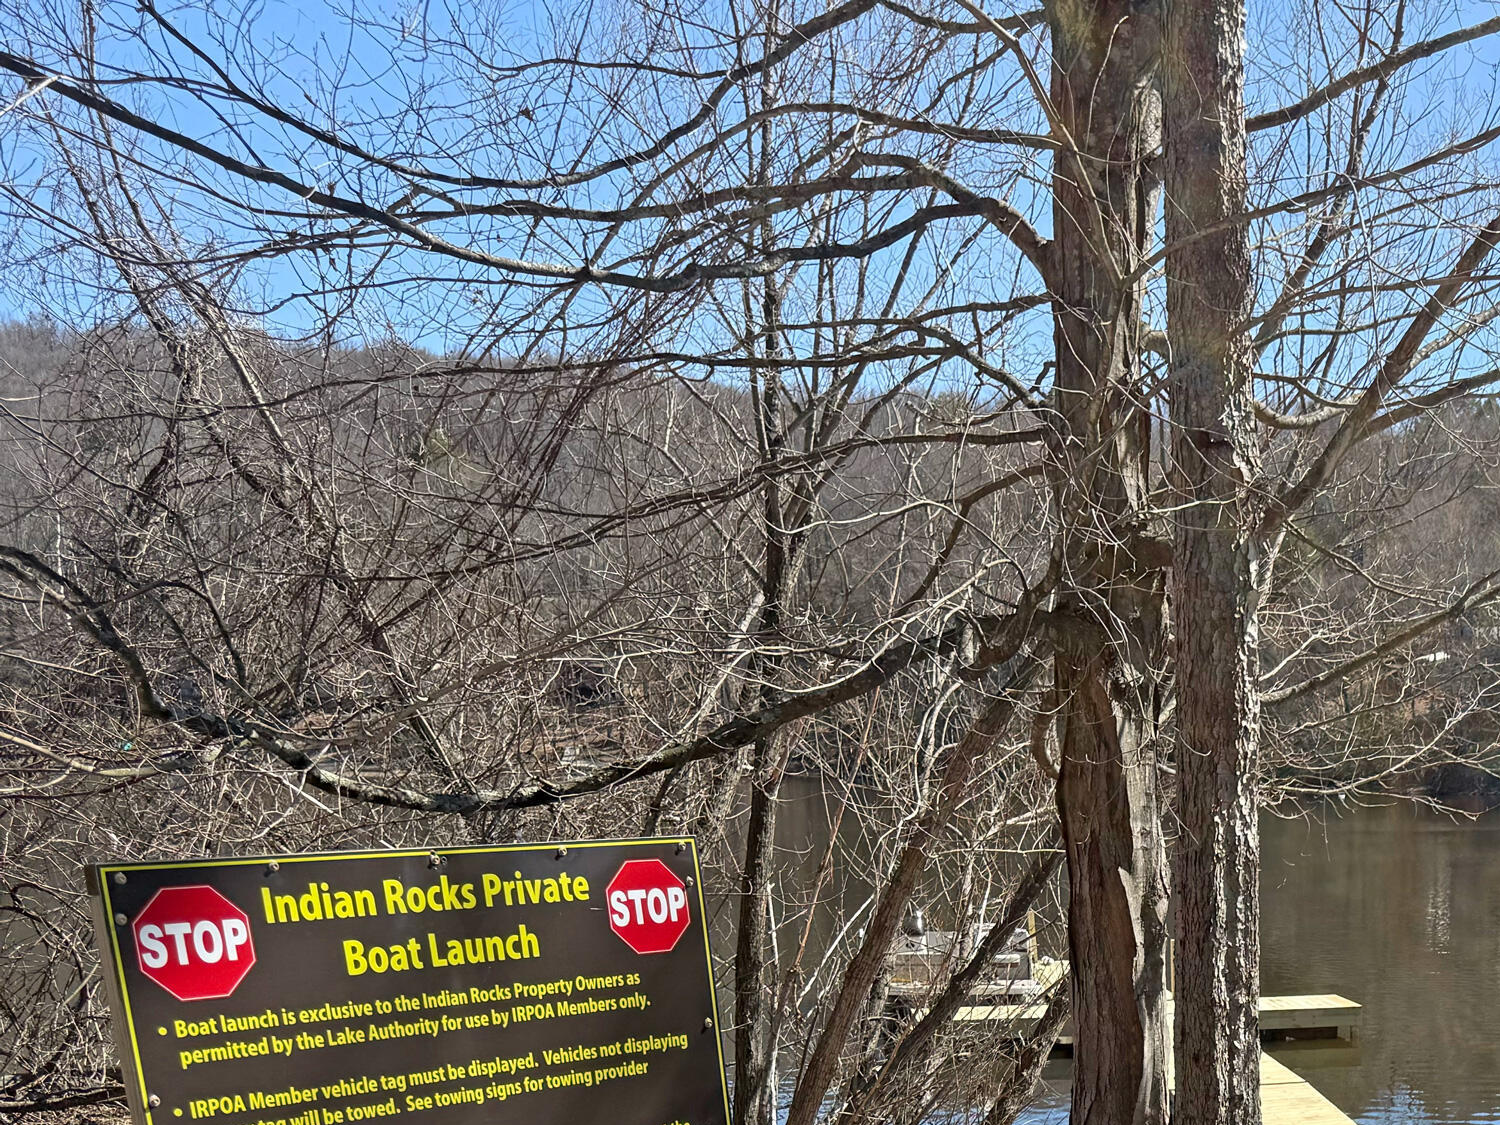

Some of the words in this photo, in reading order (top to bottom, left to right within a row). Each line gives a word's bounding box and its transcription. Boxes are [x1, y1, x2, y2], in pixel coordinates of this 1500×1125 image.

[261, 881, 378, 924] Indian
[382, 874, 477, 915] Rocks
[482, 870, 590, 907] Private
[610, 886, 686, 927] STOP
[139, 918, 249, 969] STOP
[342, 937, 424, 976] Boat
[427, 924, 541, 968] Launch
[173, 1017, 219, 1038] Boat
[219, 1009, 280, 1033] launch
[281, 1008, 297, 1026] is
[298, 1000, 373, 1024] exclusive
[374, 999, 393, 1015] to
[394, 994, 421, 1012] the
[422, 990, 469, 1009] Indian
[469, 984, 512, 1004] Rocks
[513, 978, 573, 1000] Property
[575, 974, 625, 991] Owners
[626, 973, 641, 986] as
[179, 1036, 270, 1070] permitted
[271, 1035, 293, 1057] by
[295, 1031, 325, 1050] the
[326, 1026, 366, 1047] Lake
[368, 1017, 440, 1041] Authority
[441, 1014, 463, 1032] for
[464, 1014, 490, 1029] use
[490, 1009, 509, 1028] by
[511, 1002, 556, 1023] IRPOA
[556, 997, 618, 1017] Members
[619, 991, 651, 1010] only.
[189, 1094, 247, 1119] IRPOA
[248, 1086, 319, 1111] Member
[320, 1075, 378, 1099] vehicle
[379, 1075, 407, 1093] tag
[408, 1066, 447, 1087] must
[447, 1063, 466, 1081] be
[467, 1051, 539, 1079] displayed.
[542, 1044, 598, 1066] Vehicles
[599, 1041, 622, 1058] not
[623, 1032, 688, 1055] displaying
[322, 1108, 344, 1125] be
[345, 1097, 401, 1122] towed.
[405, 1095, 433, 1112] See
[433, 1086, 485, 1107] towing
[485, 1081, 523, 1101] signs
[523, 1076, 544, 1093] for
[545, 1069, 593, 1089] towing
[594, 1060, 649, 1085] provider
